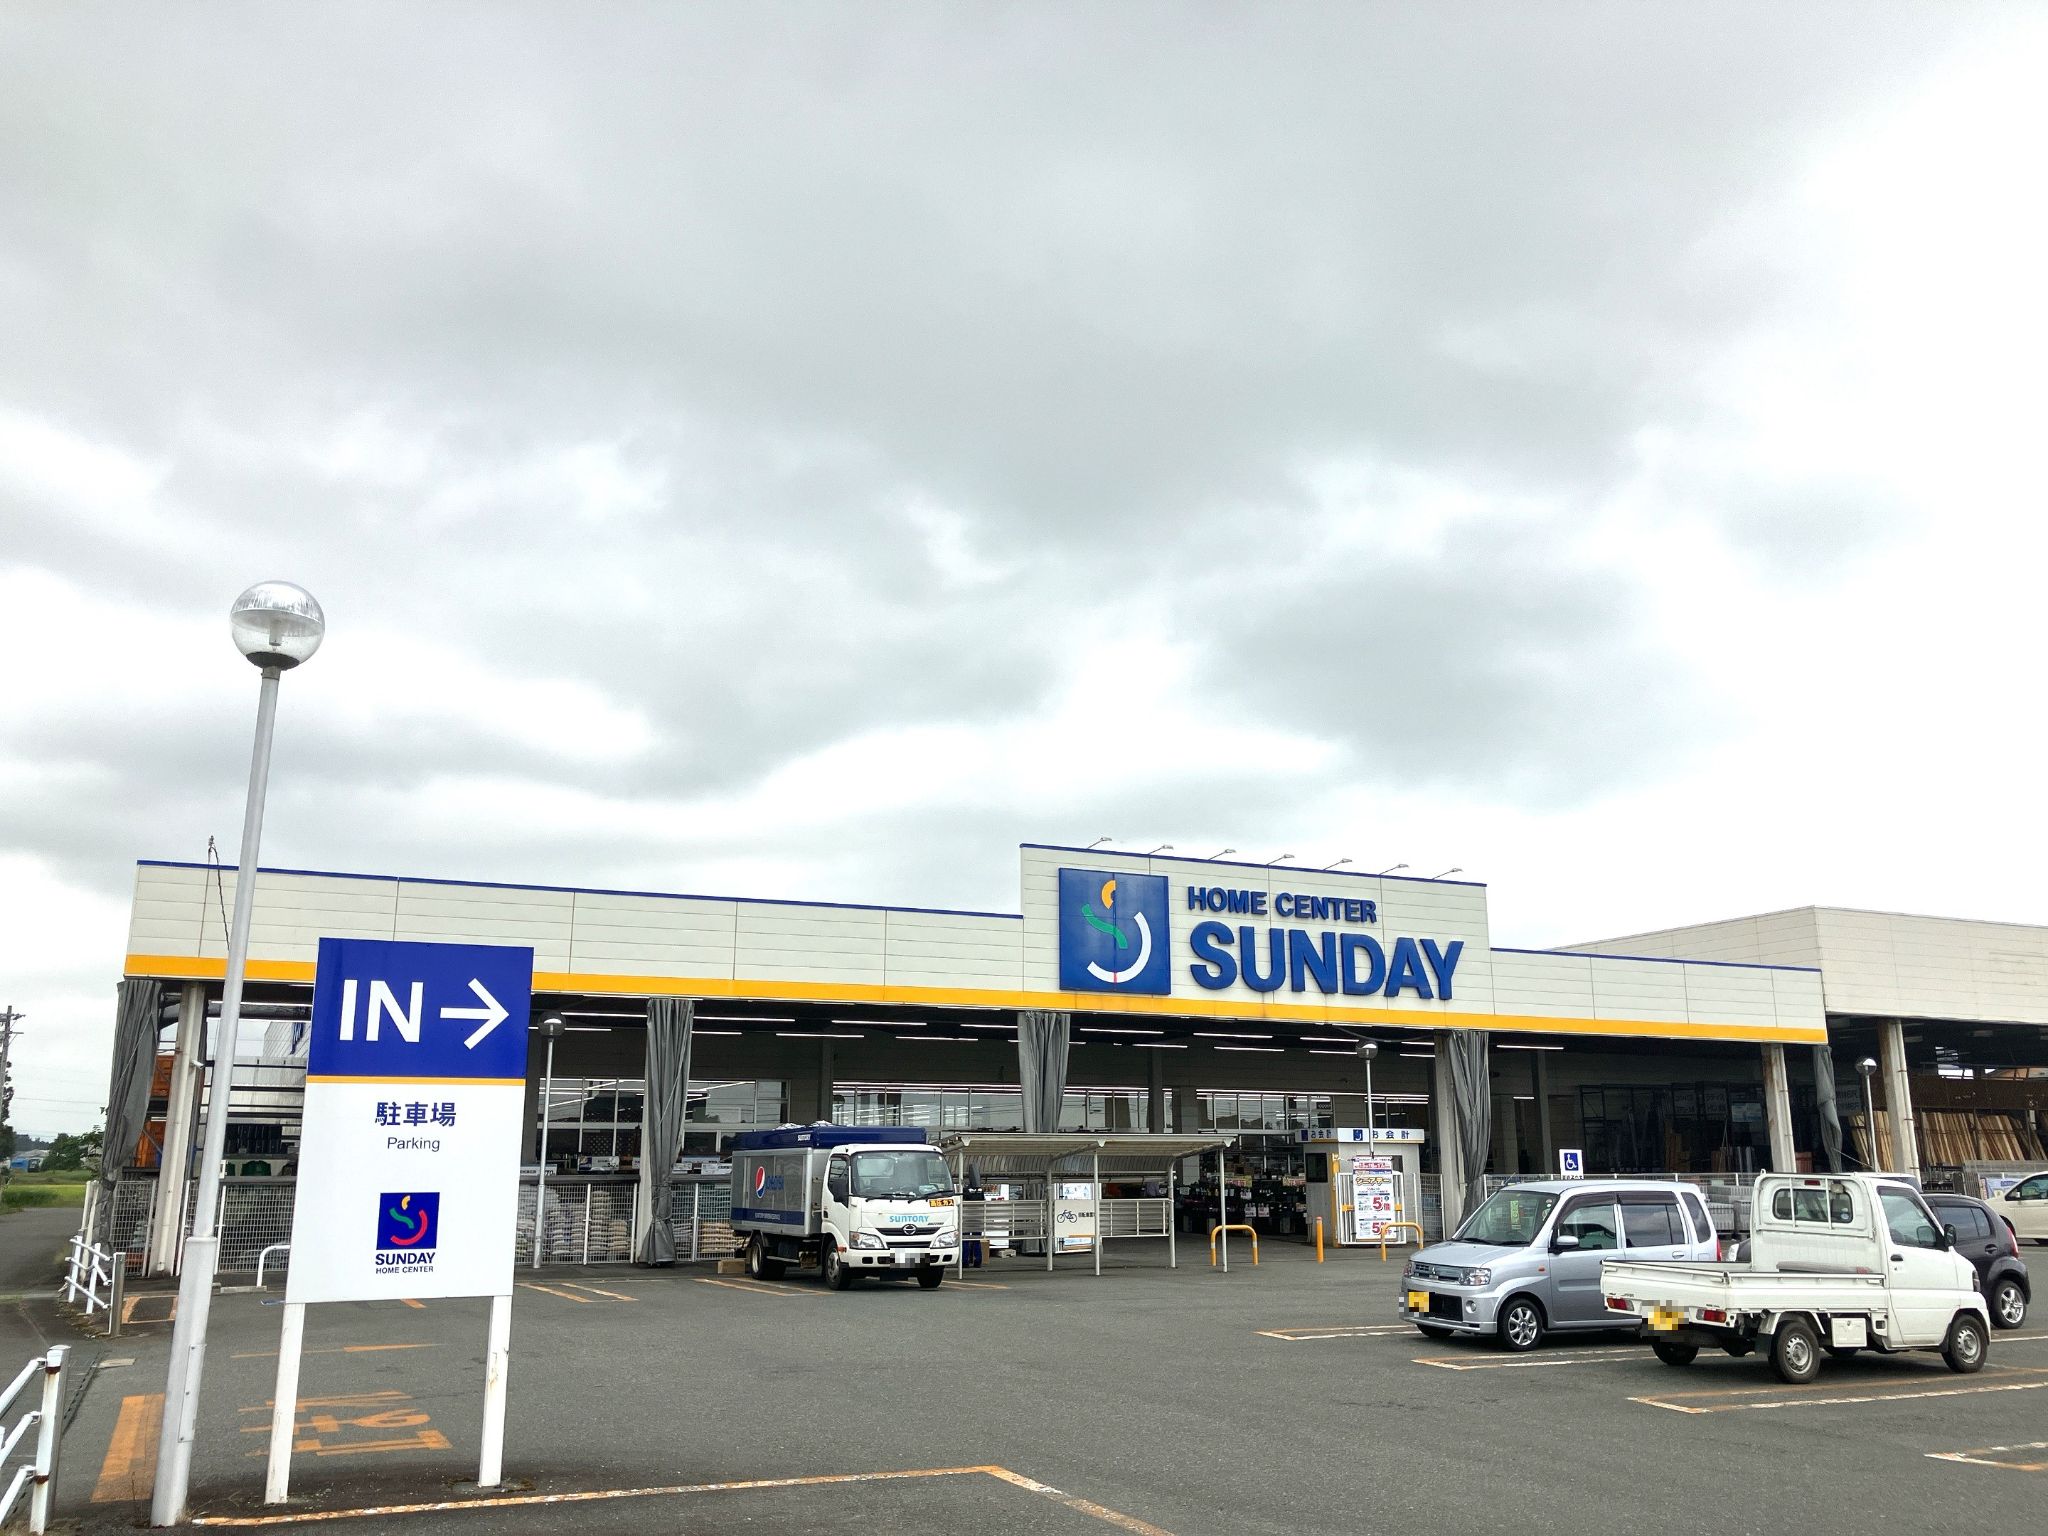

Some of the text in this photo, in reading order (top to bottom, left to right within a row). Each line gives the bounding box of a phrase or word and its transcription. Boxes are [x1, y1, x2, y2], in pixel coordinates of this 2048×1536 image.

[1188, 886, 1377, 923] HOME CENTER
[1190, 921, 1464, 1000] SUNDAY
[339, 979, 424, 1042] IN
[374, 1101, 457, 1127] 駐車場
[387, 1136, 441, 1153] Parking
[889, 1215, 930, 1223] SUNTORY
[375, 1252, 436, 1266] SUNDAY
[375, 1265, 434, 1274] HOME CENTER
